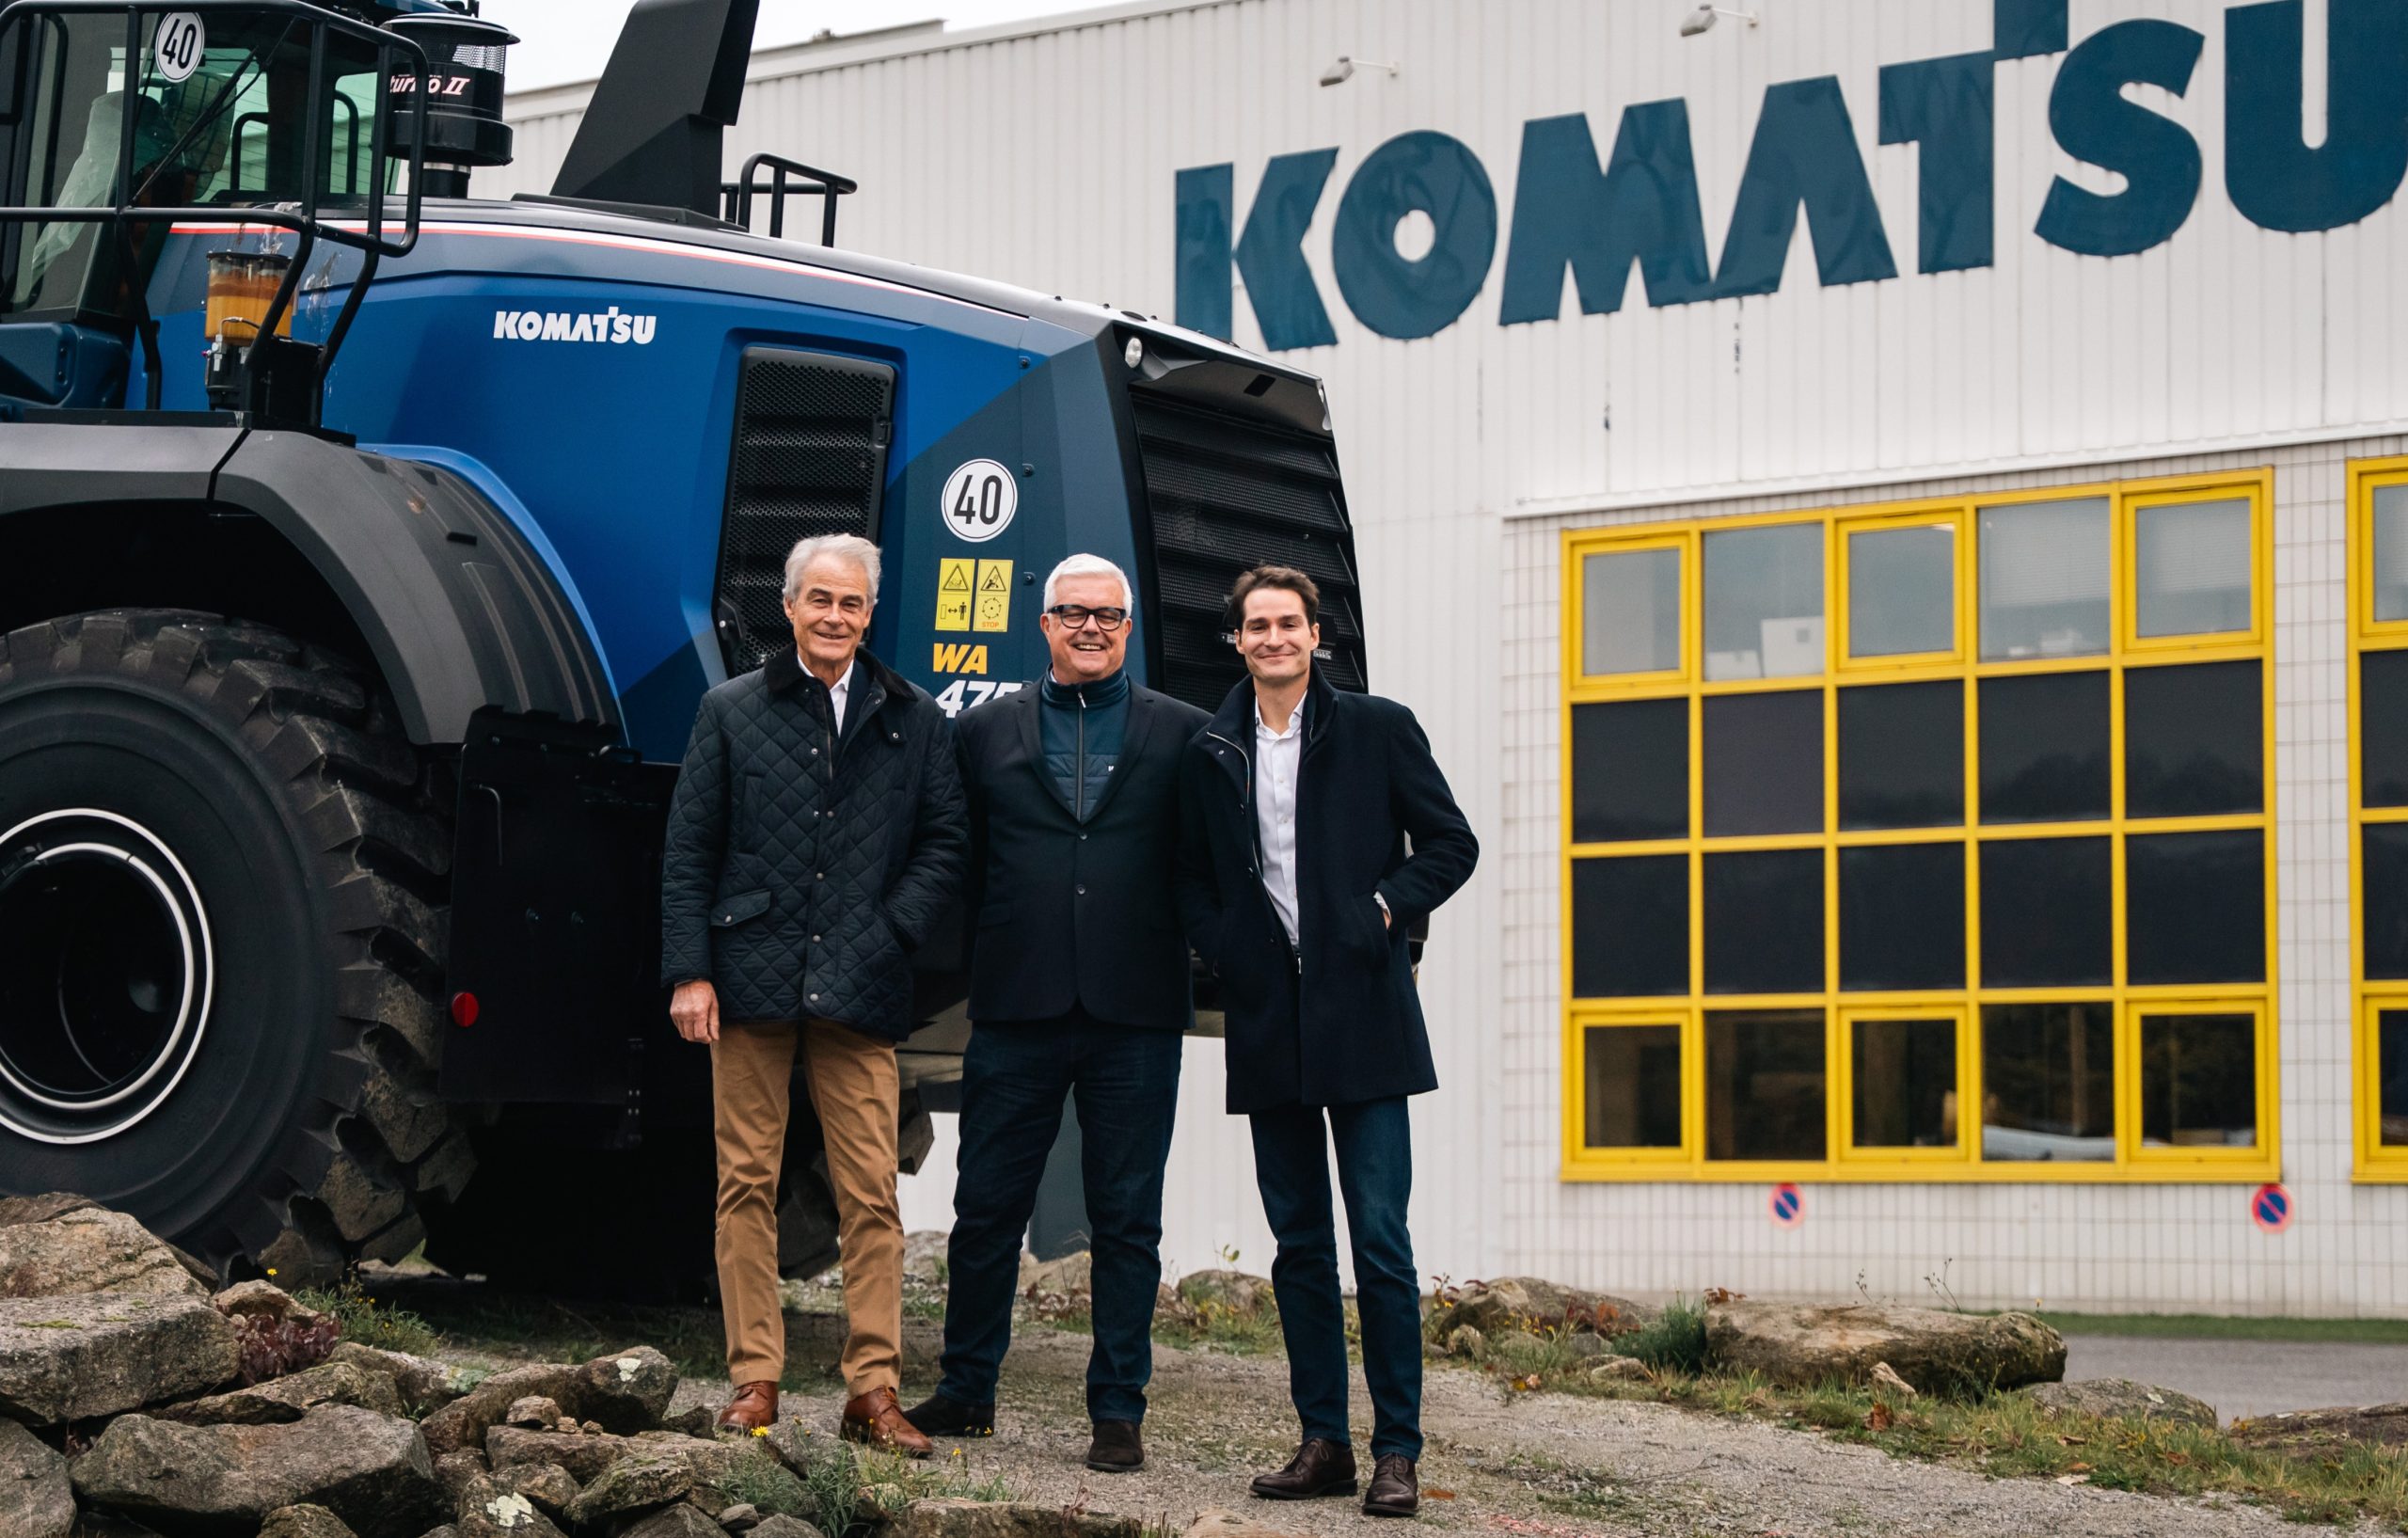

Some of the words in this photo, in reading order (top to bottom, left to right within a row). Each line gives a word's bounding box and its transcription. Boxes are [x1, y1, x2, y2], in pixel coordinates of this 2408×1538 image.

[162, 18, 197, 70] 40
[389, 75, 441, 94] turo
[441, 76, 471, 96] II
[1175, 0, 2408, 351] KOMATSU
[493, 306, 657, 344] KOMATSU
[954, 474, 1003, 525] 40
[933, 642, 988, 674] WA
